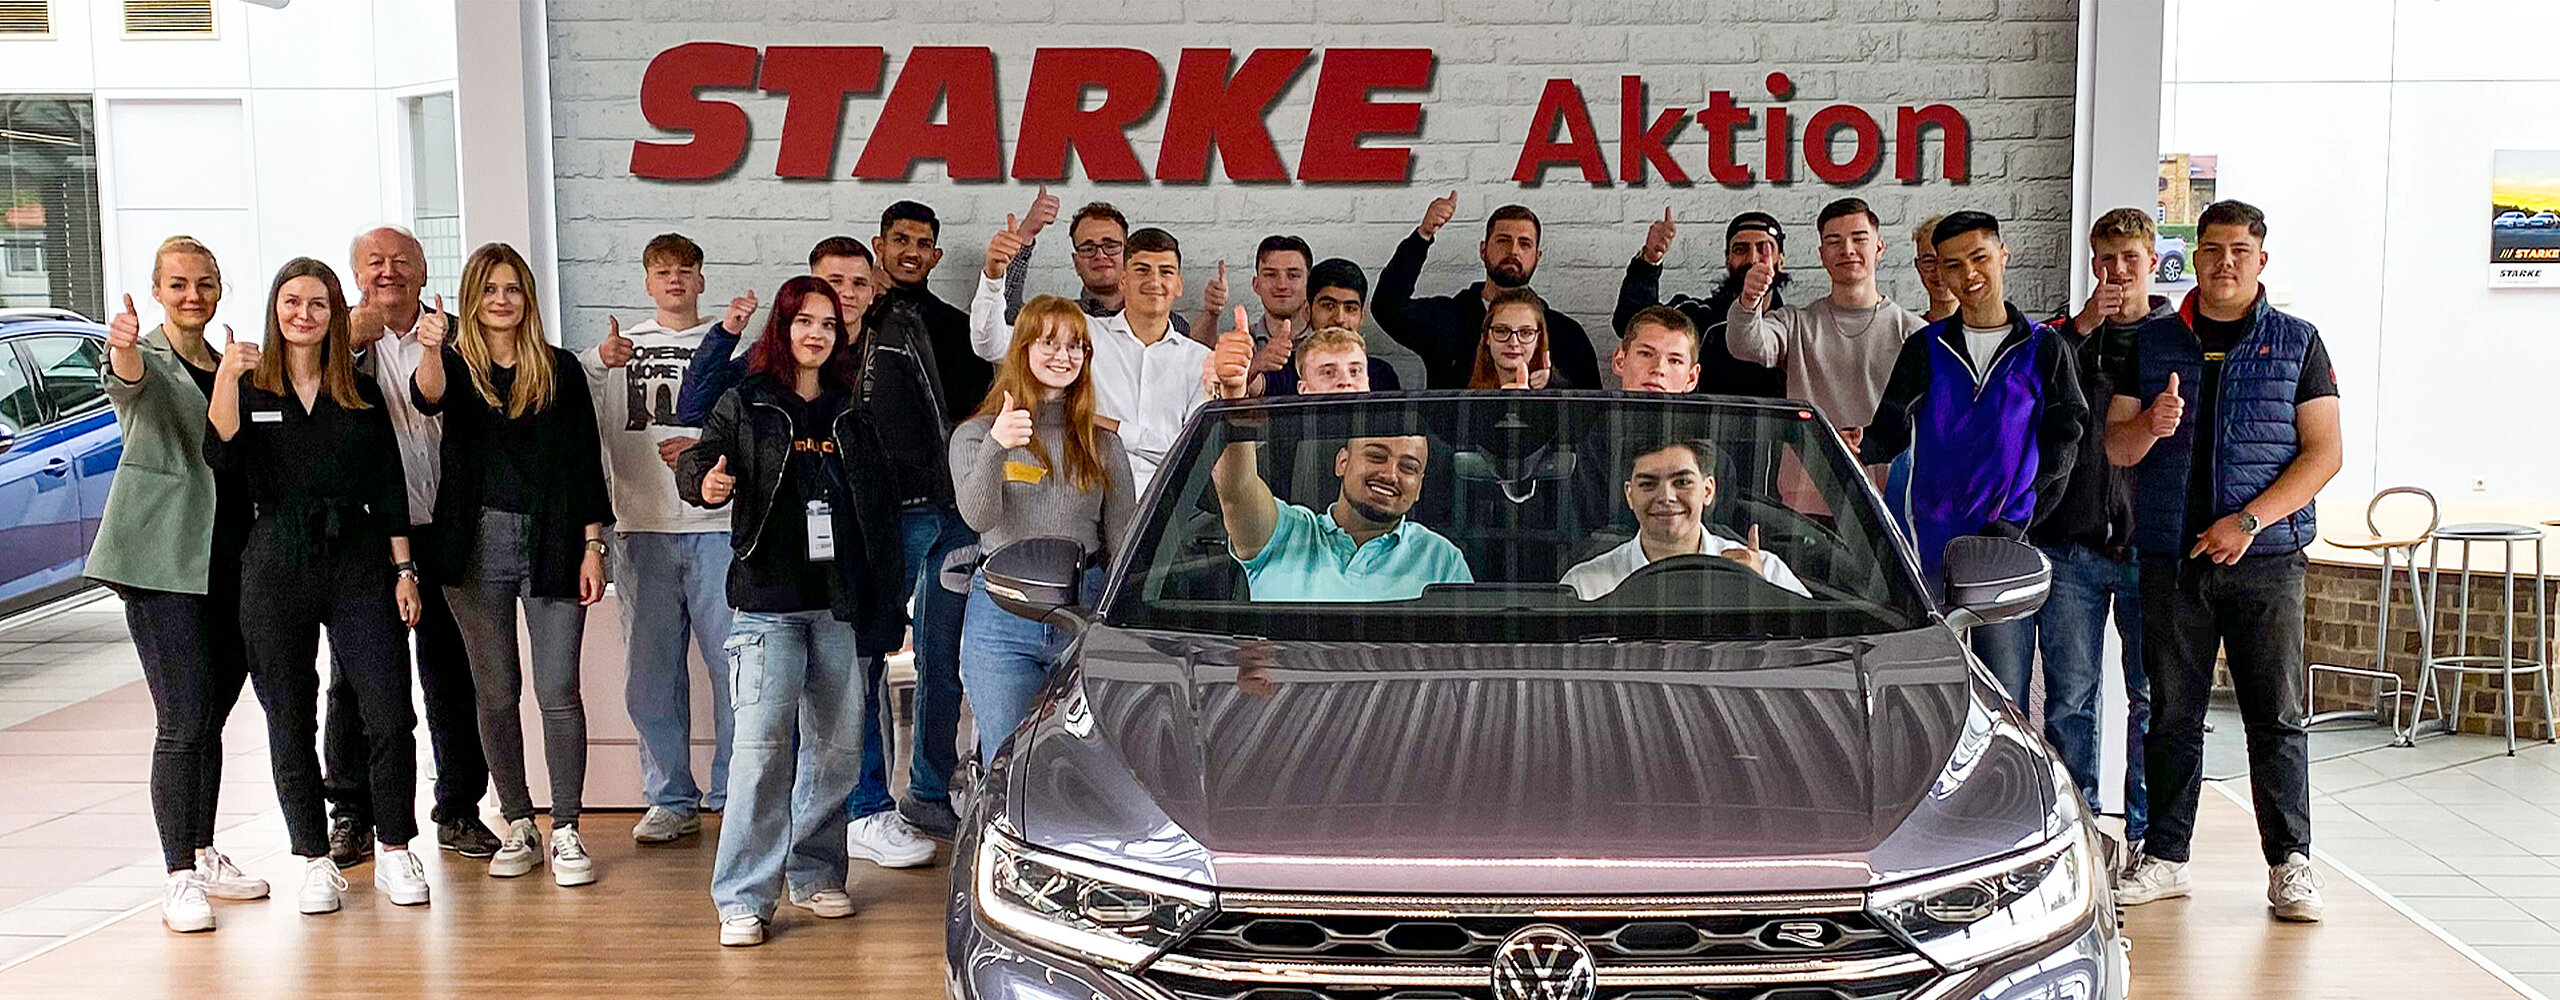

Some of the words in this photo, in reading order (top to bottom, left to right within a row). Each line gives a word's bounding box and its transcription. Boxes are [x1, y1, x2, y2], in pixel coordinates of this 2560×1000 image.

[630, 42, 1434, 183] STARKE
[1512, 72, 1968, 186] Aktion
[2499, 269, 2542, 277] STARKE
